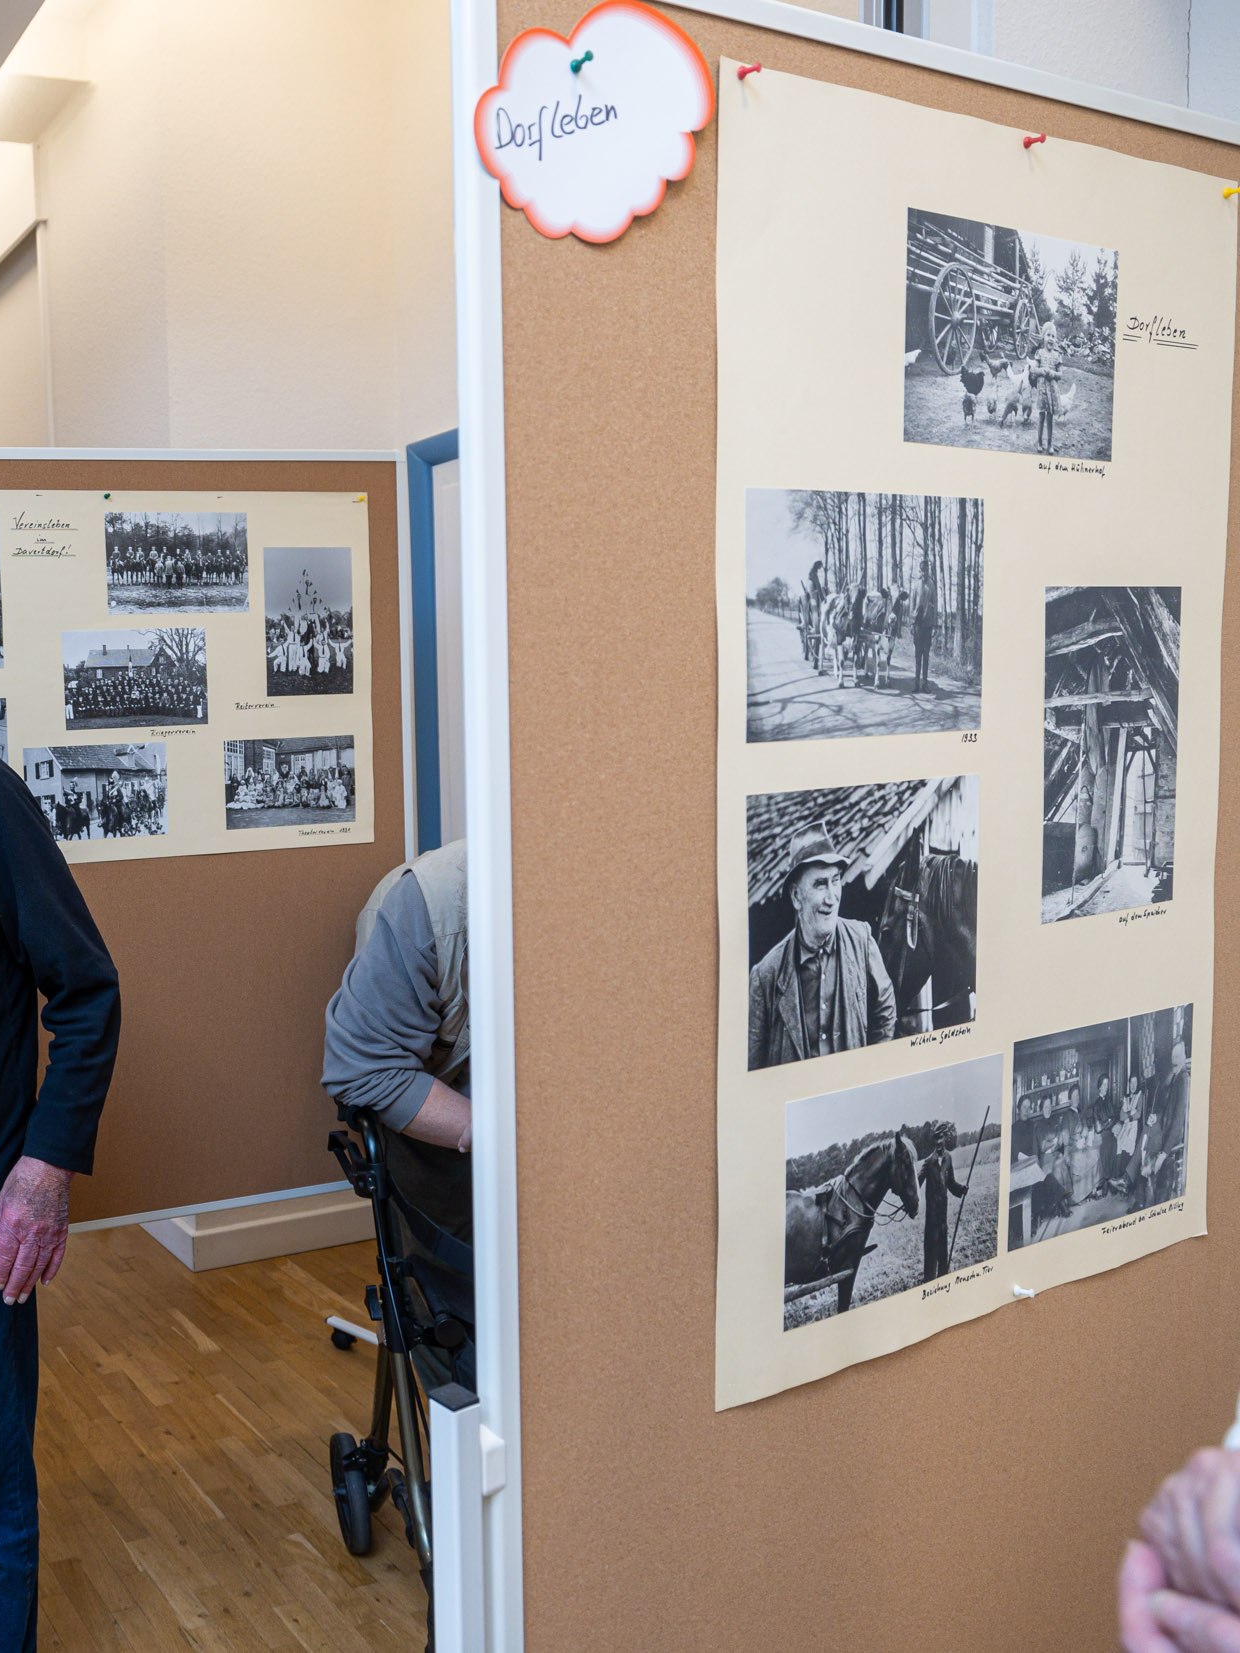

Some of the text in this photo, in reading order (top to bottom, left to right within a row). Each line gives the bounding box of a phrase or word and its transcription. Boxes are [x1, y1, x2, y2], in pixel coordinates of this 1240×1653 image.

[494, 93, 618, 162] Dorfleben
[1126, 315, 1187, 344] Dorfleben
[1038, 461, 1106, 479] auf dem Hühnerhof
[11, 511, 71, 530] Vereinsleben
[149, 728, 197, 738] Kriegerverein
[960, 732, 978, 743] 1933
[1130, 911, 1143, 921] dem
[910, 1026, 972, 1048] Wilhelm Goldstein
[1101, 1217, 1138, 1235] Feierabend
[921, 1282, 951, 1301] Beziehung
